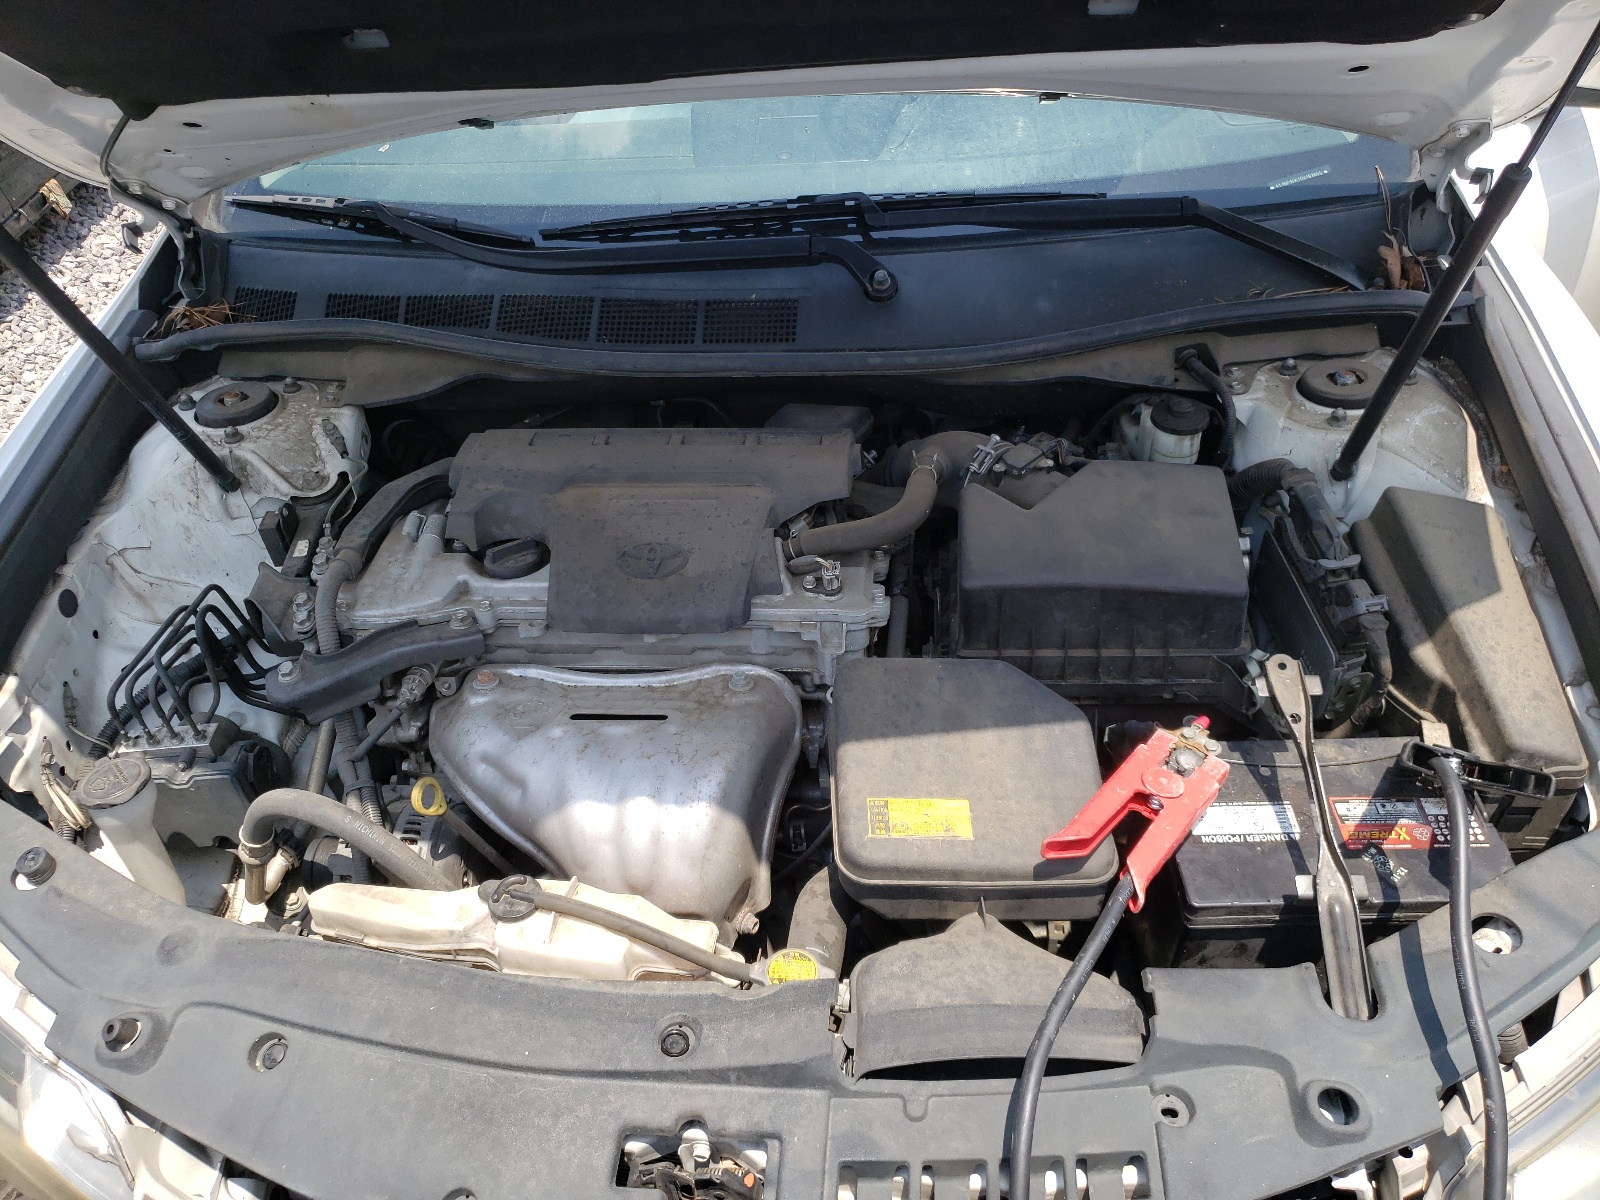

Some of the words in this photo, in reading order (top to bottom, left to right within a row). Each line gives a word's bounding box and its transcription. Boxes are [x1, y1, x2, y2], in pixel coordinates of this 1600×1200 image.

[353, 820, 386, 845] NICHIRIN
[1245, 833, 1289, 842] DANGER
[1349, 827, 1411, 841] XTREME
